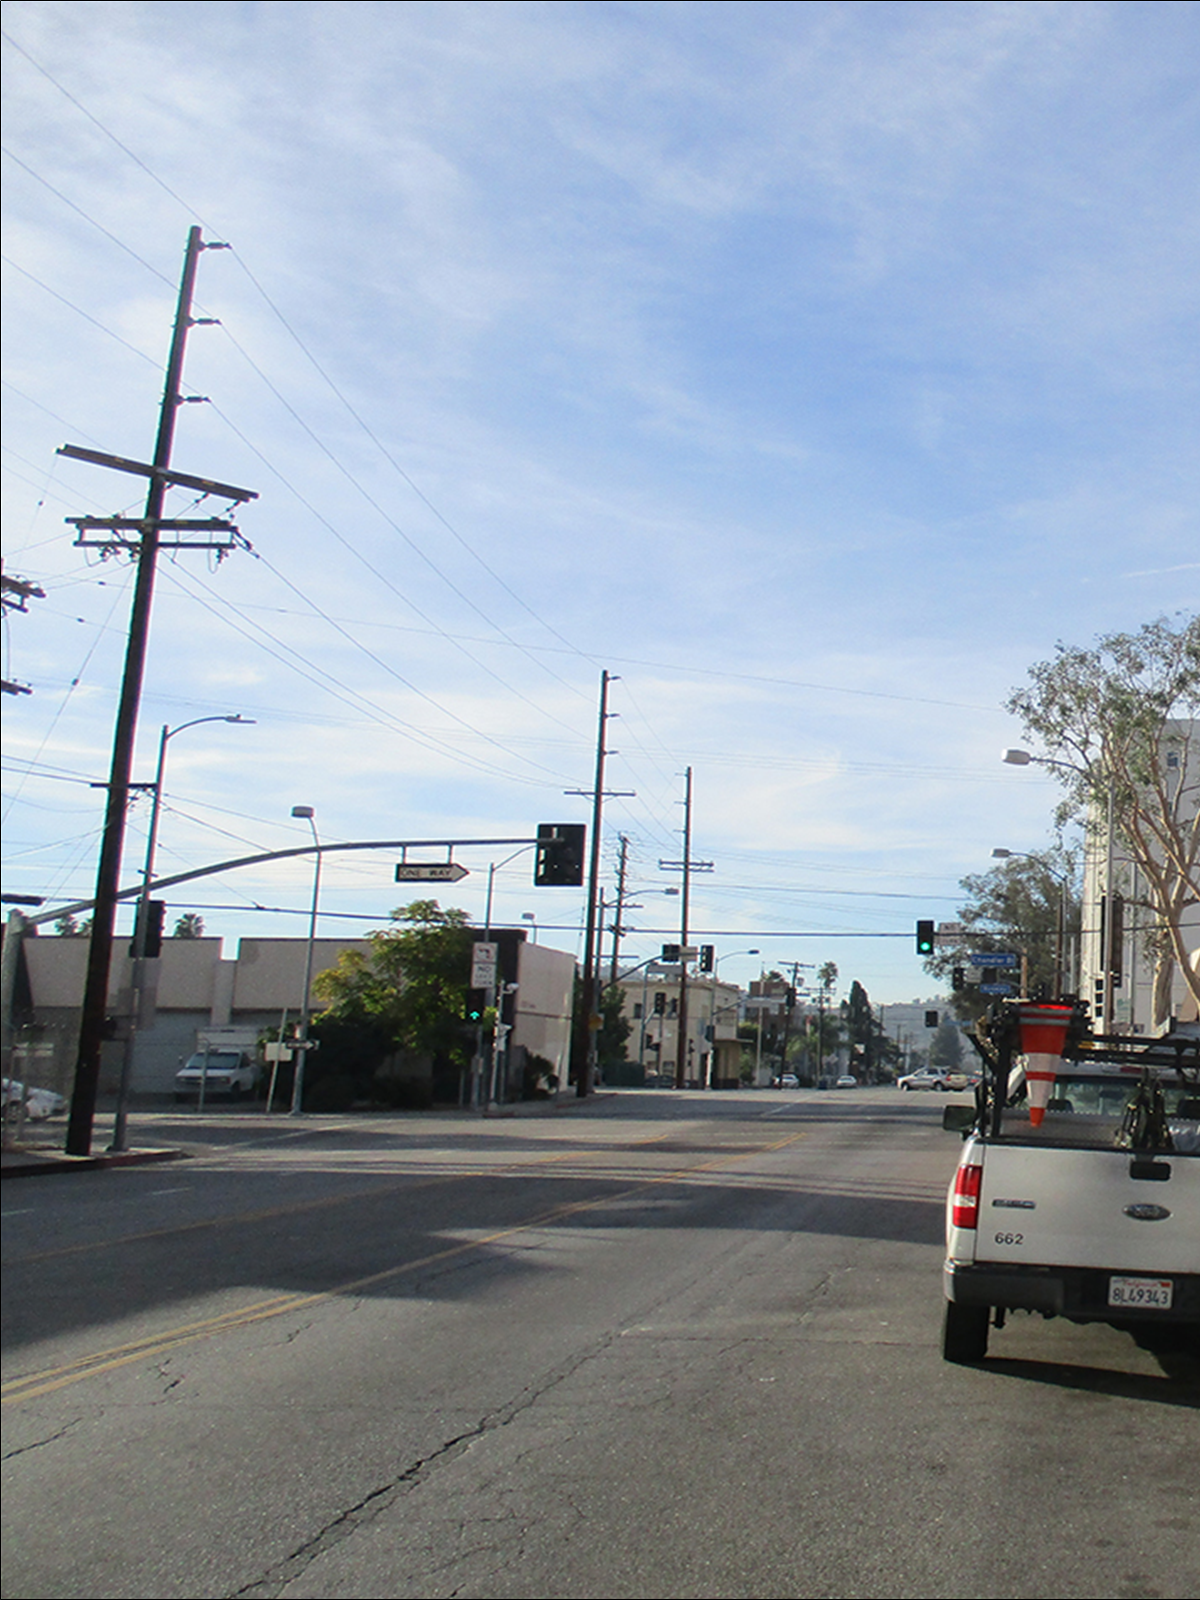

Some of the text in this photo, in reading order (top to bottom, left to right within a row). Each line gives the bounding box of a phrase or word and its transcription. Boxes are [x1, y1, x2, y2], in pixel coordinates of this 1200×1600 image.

[399, 867, 452, 878] ONE WAY
[477, 965, 492, 973] NO
[994, 1231, 1025, 1246] 662
[1112, 1287, 1169, 1305] 8L49343
